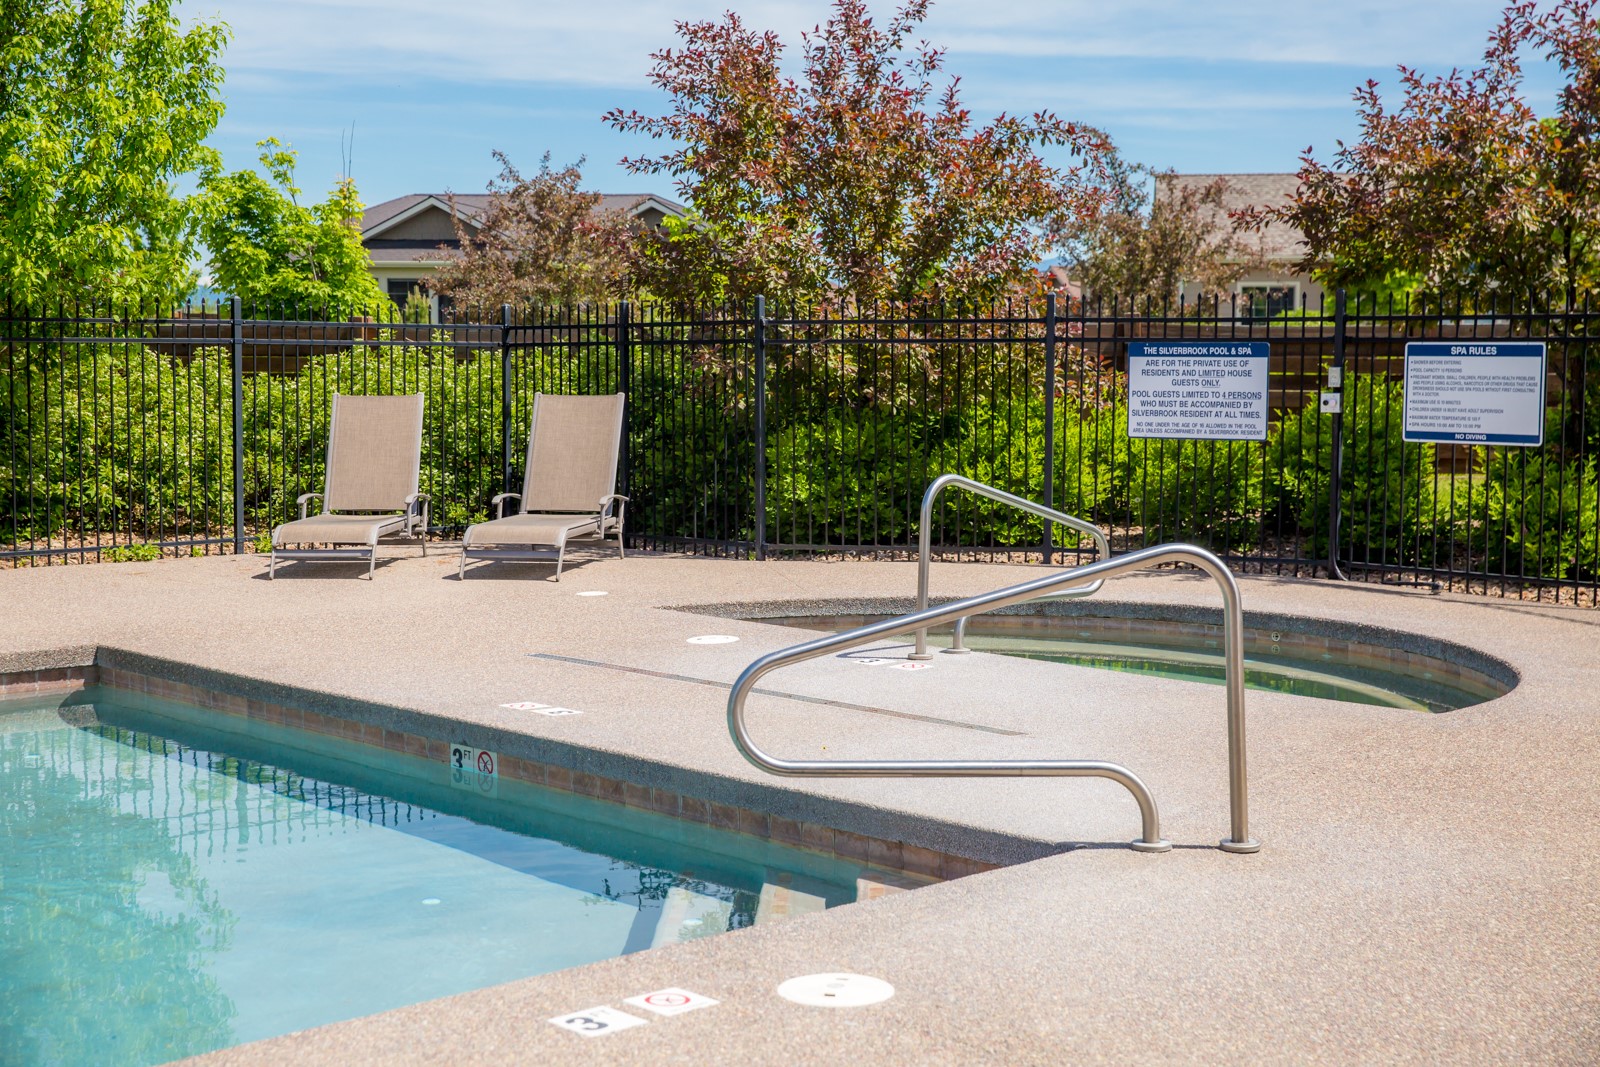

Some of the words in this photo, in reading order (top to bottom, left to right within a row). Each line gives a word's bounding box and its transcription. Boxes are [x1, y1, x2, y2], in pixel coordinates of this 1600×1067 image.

[1159, 347, 1209, 355] SILVERBROOK
[1210, 347, 1230, 355] POOL
[1231, 347, 1236, 355] &
[1237, 347, 1252, 355] SPA
[1450, 347, 1467, 355] SPA
[1469, 347, 1497, 355] RULES
[1182, 369, 1196, 377] AND
[1171, 379, 1200, 387] GUESTS
[1202, 379, 1221, 387] ONLY.
[1158, 400, 1177, 408] MUST
[1180, 400, 1189, 408] BE
[1243, 401, 1253, 409] BY
[1239, 411, 1261, 419] TIMES.
[453, 748, 463, 768] 3
[463, 750, 471, 761] FT
[566, 1017, 609, 1030] 3
